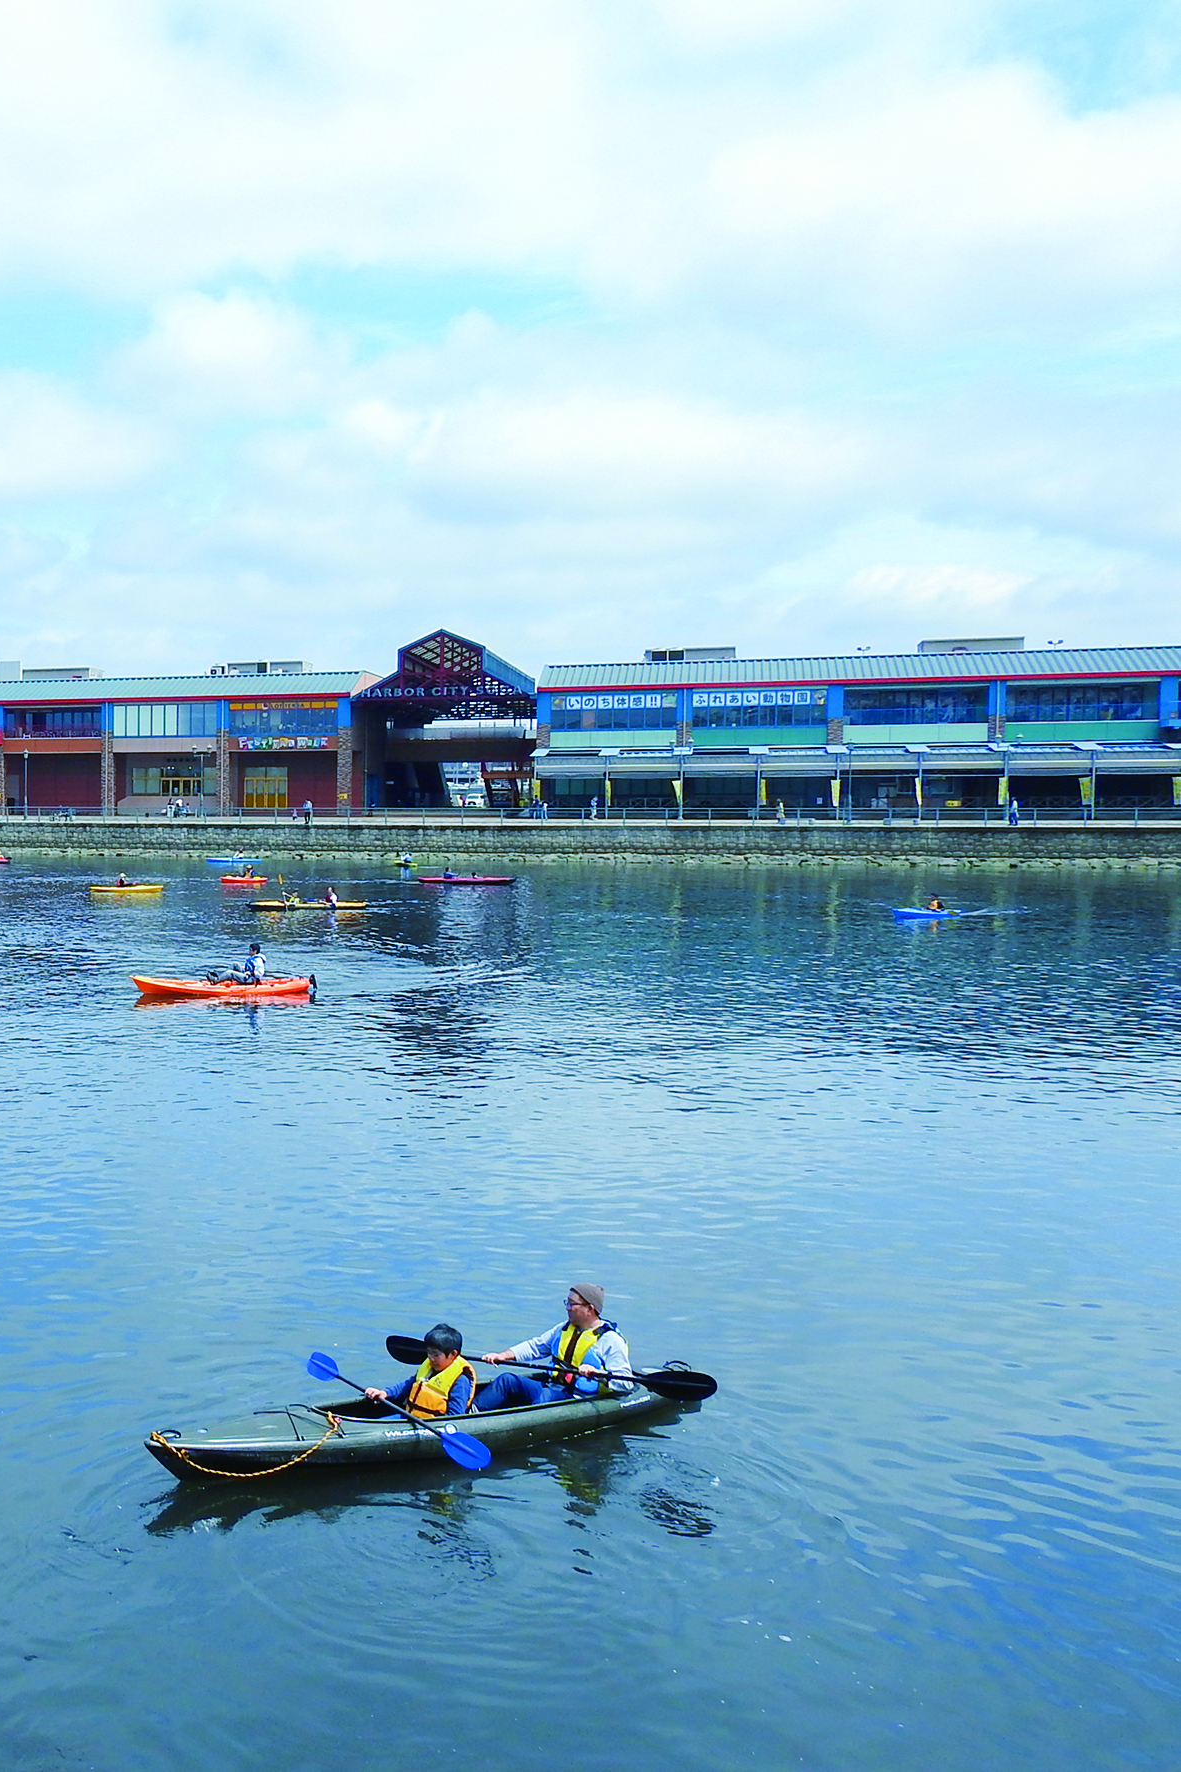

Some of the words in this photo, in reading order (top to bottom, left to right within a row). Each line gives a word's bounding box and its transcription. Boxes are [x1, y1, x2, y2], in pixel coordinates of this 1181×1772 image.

[360, 687, 425, 698] HARBOR
[431, 686, 469, 697] CITY
[568, 696, 658, 708] いのち体感!!
[695, 692, 808, 705] ふれあい動物園
[238, 737, 295, 750] FESTIVAL
